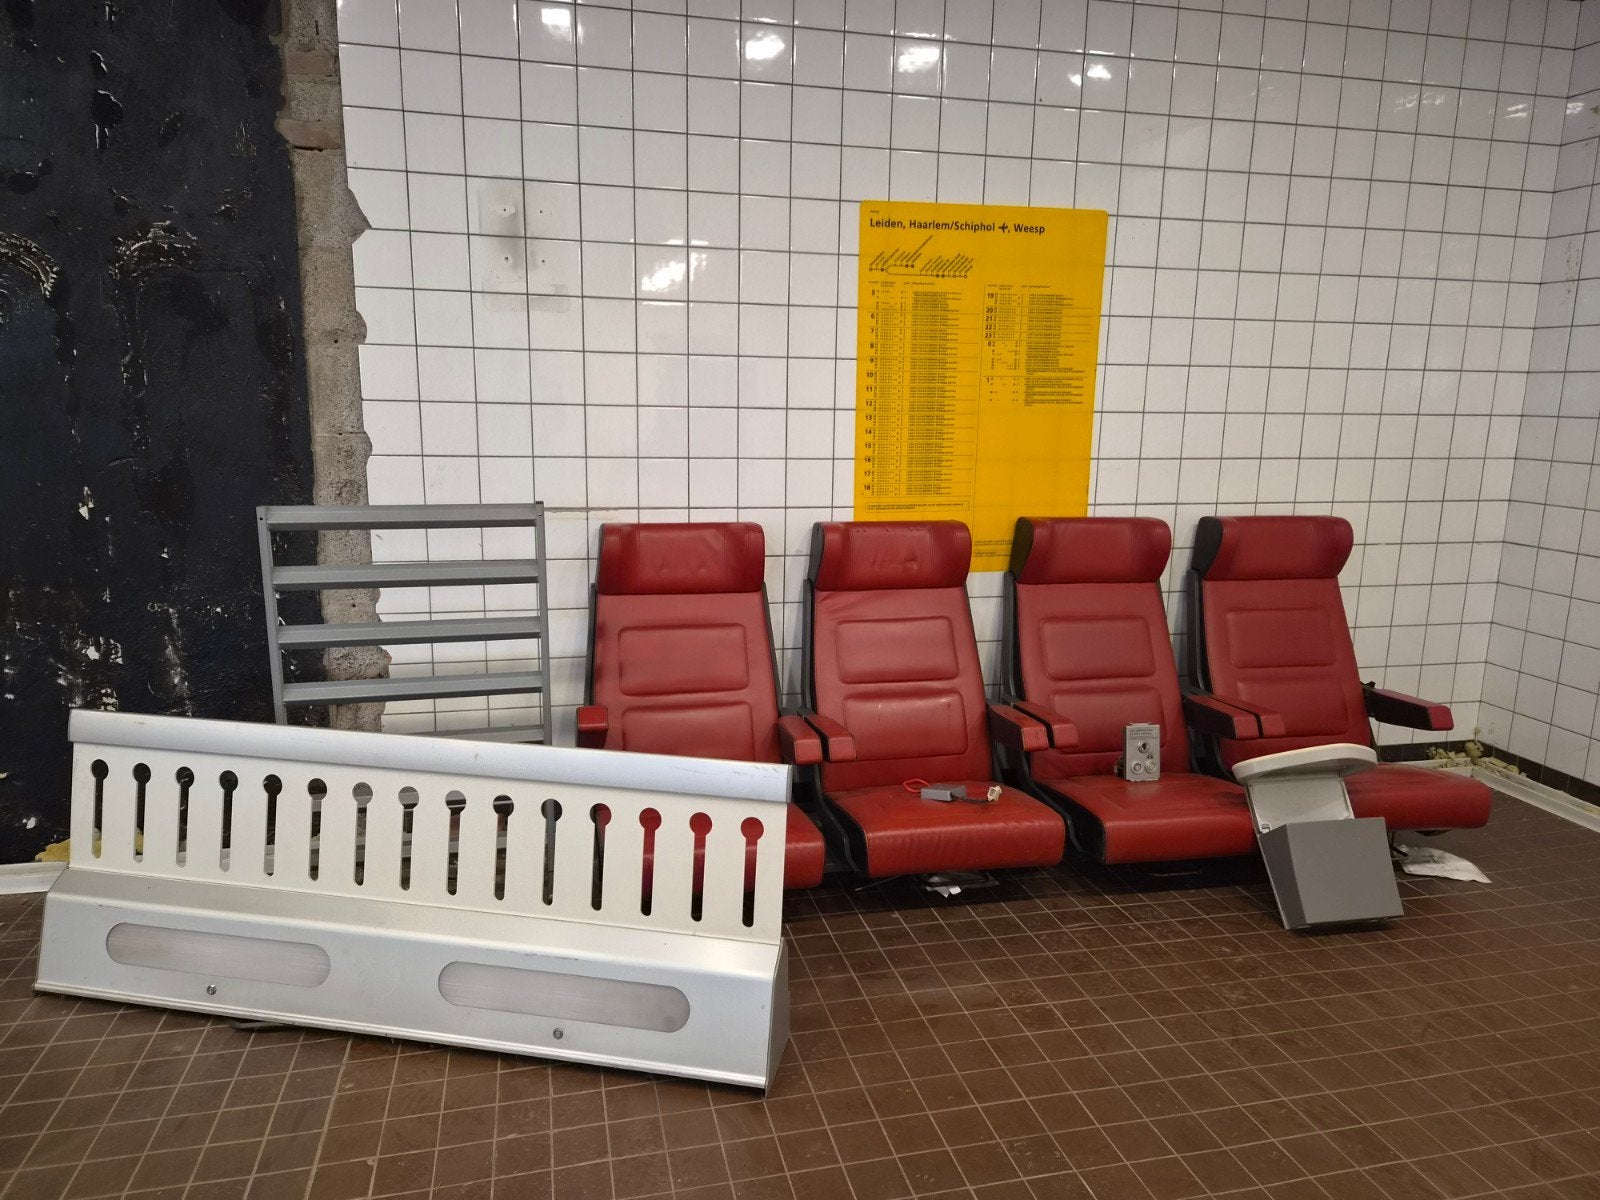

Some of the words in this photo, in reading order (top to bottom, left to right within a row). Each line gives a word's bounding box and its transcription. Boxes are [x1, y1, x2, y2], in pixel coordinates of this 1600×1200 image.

[870, 218, 906, 230] Leiden,
[910, 220, 995, 233] Haarlem/Schiphol
[1014, 224, 1045, 235] Weesp
